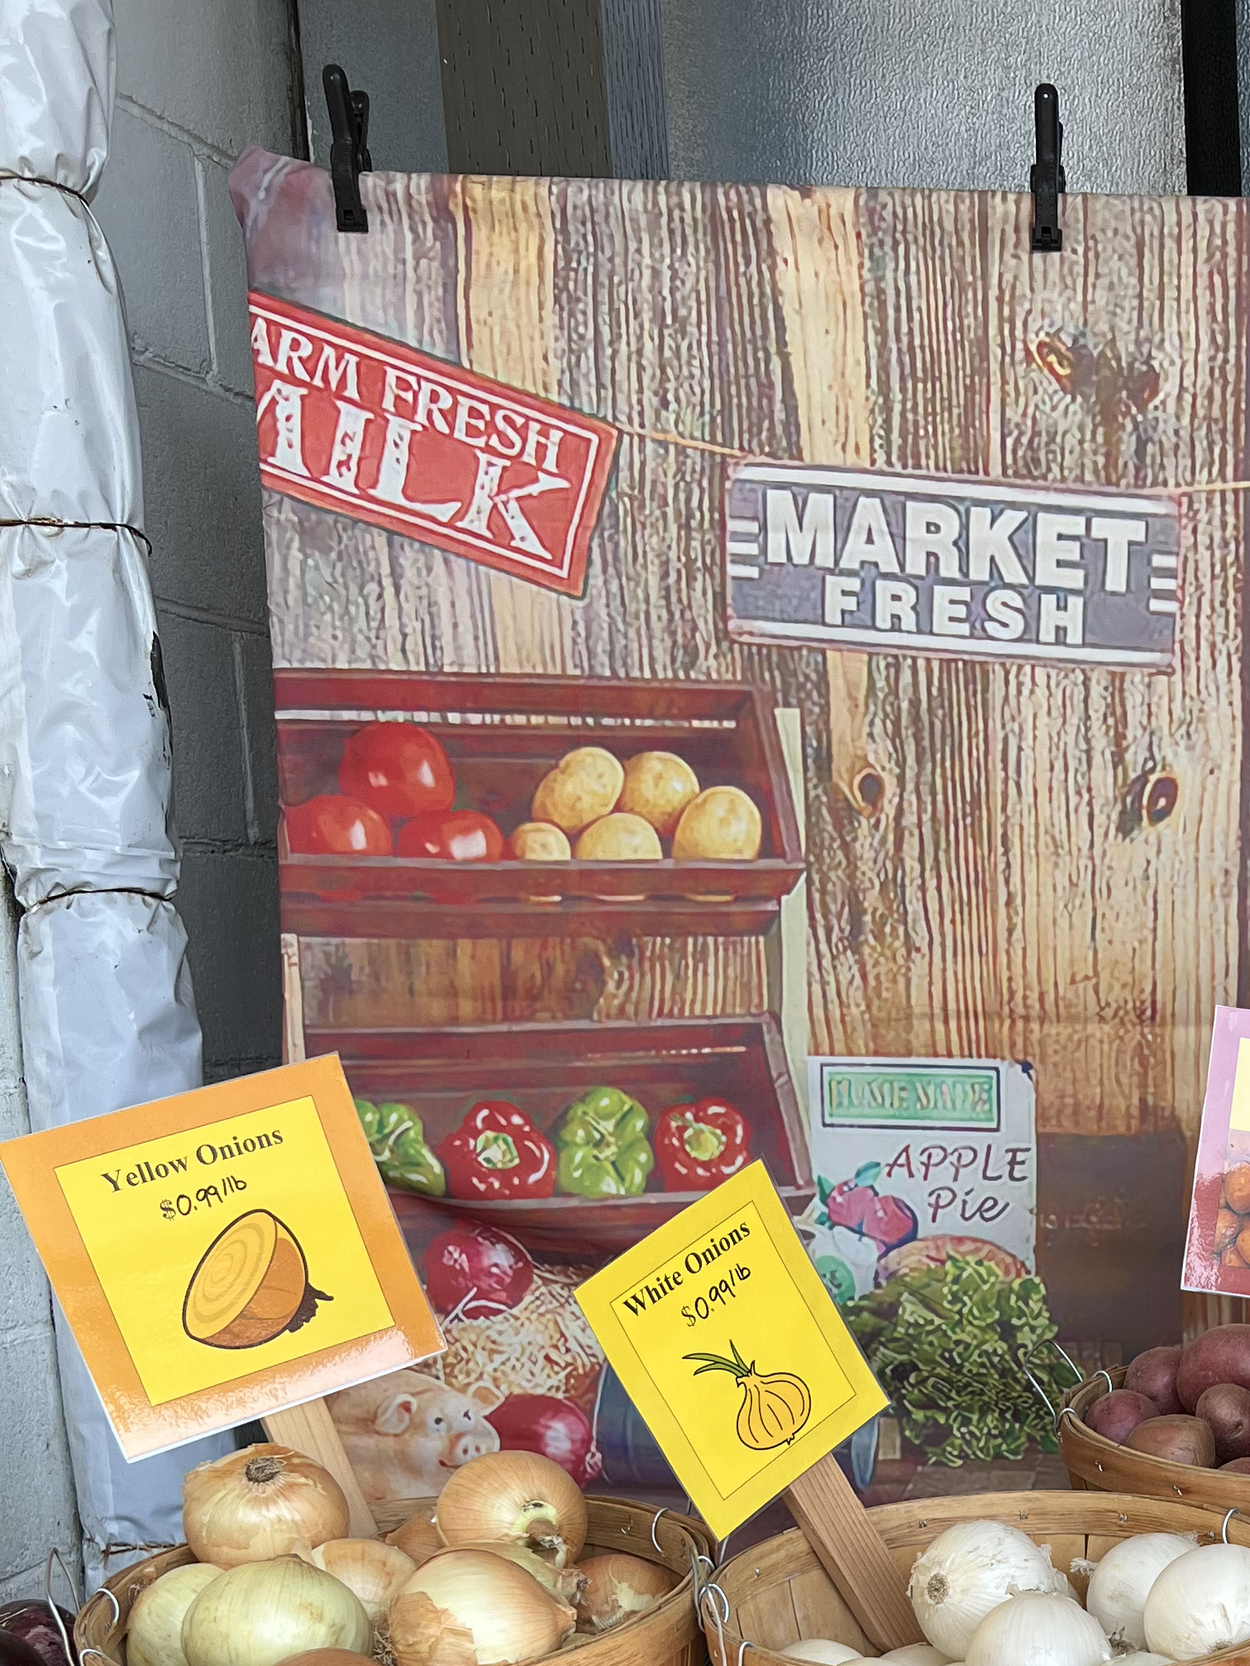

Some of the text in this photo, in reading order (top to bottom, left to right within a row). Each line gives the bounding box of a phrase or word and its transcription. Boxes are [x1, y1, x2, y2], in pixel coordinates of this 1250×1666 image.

[381, 366, 563, 473] FRESH
[765, 488, 1147, 593] MARKET
[824, 575, 1084, 645] FRESH
[101, 1127, 284, 1194] Yellow Onions
[885, 1143, 1032, 1182] APPLE
[928, 1186, 1010, 1223] Pie
[622, 1221, 751, 1317] White Onions
[681, 1263, 751, 1327] $0.99/lb
